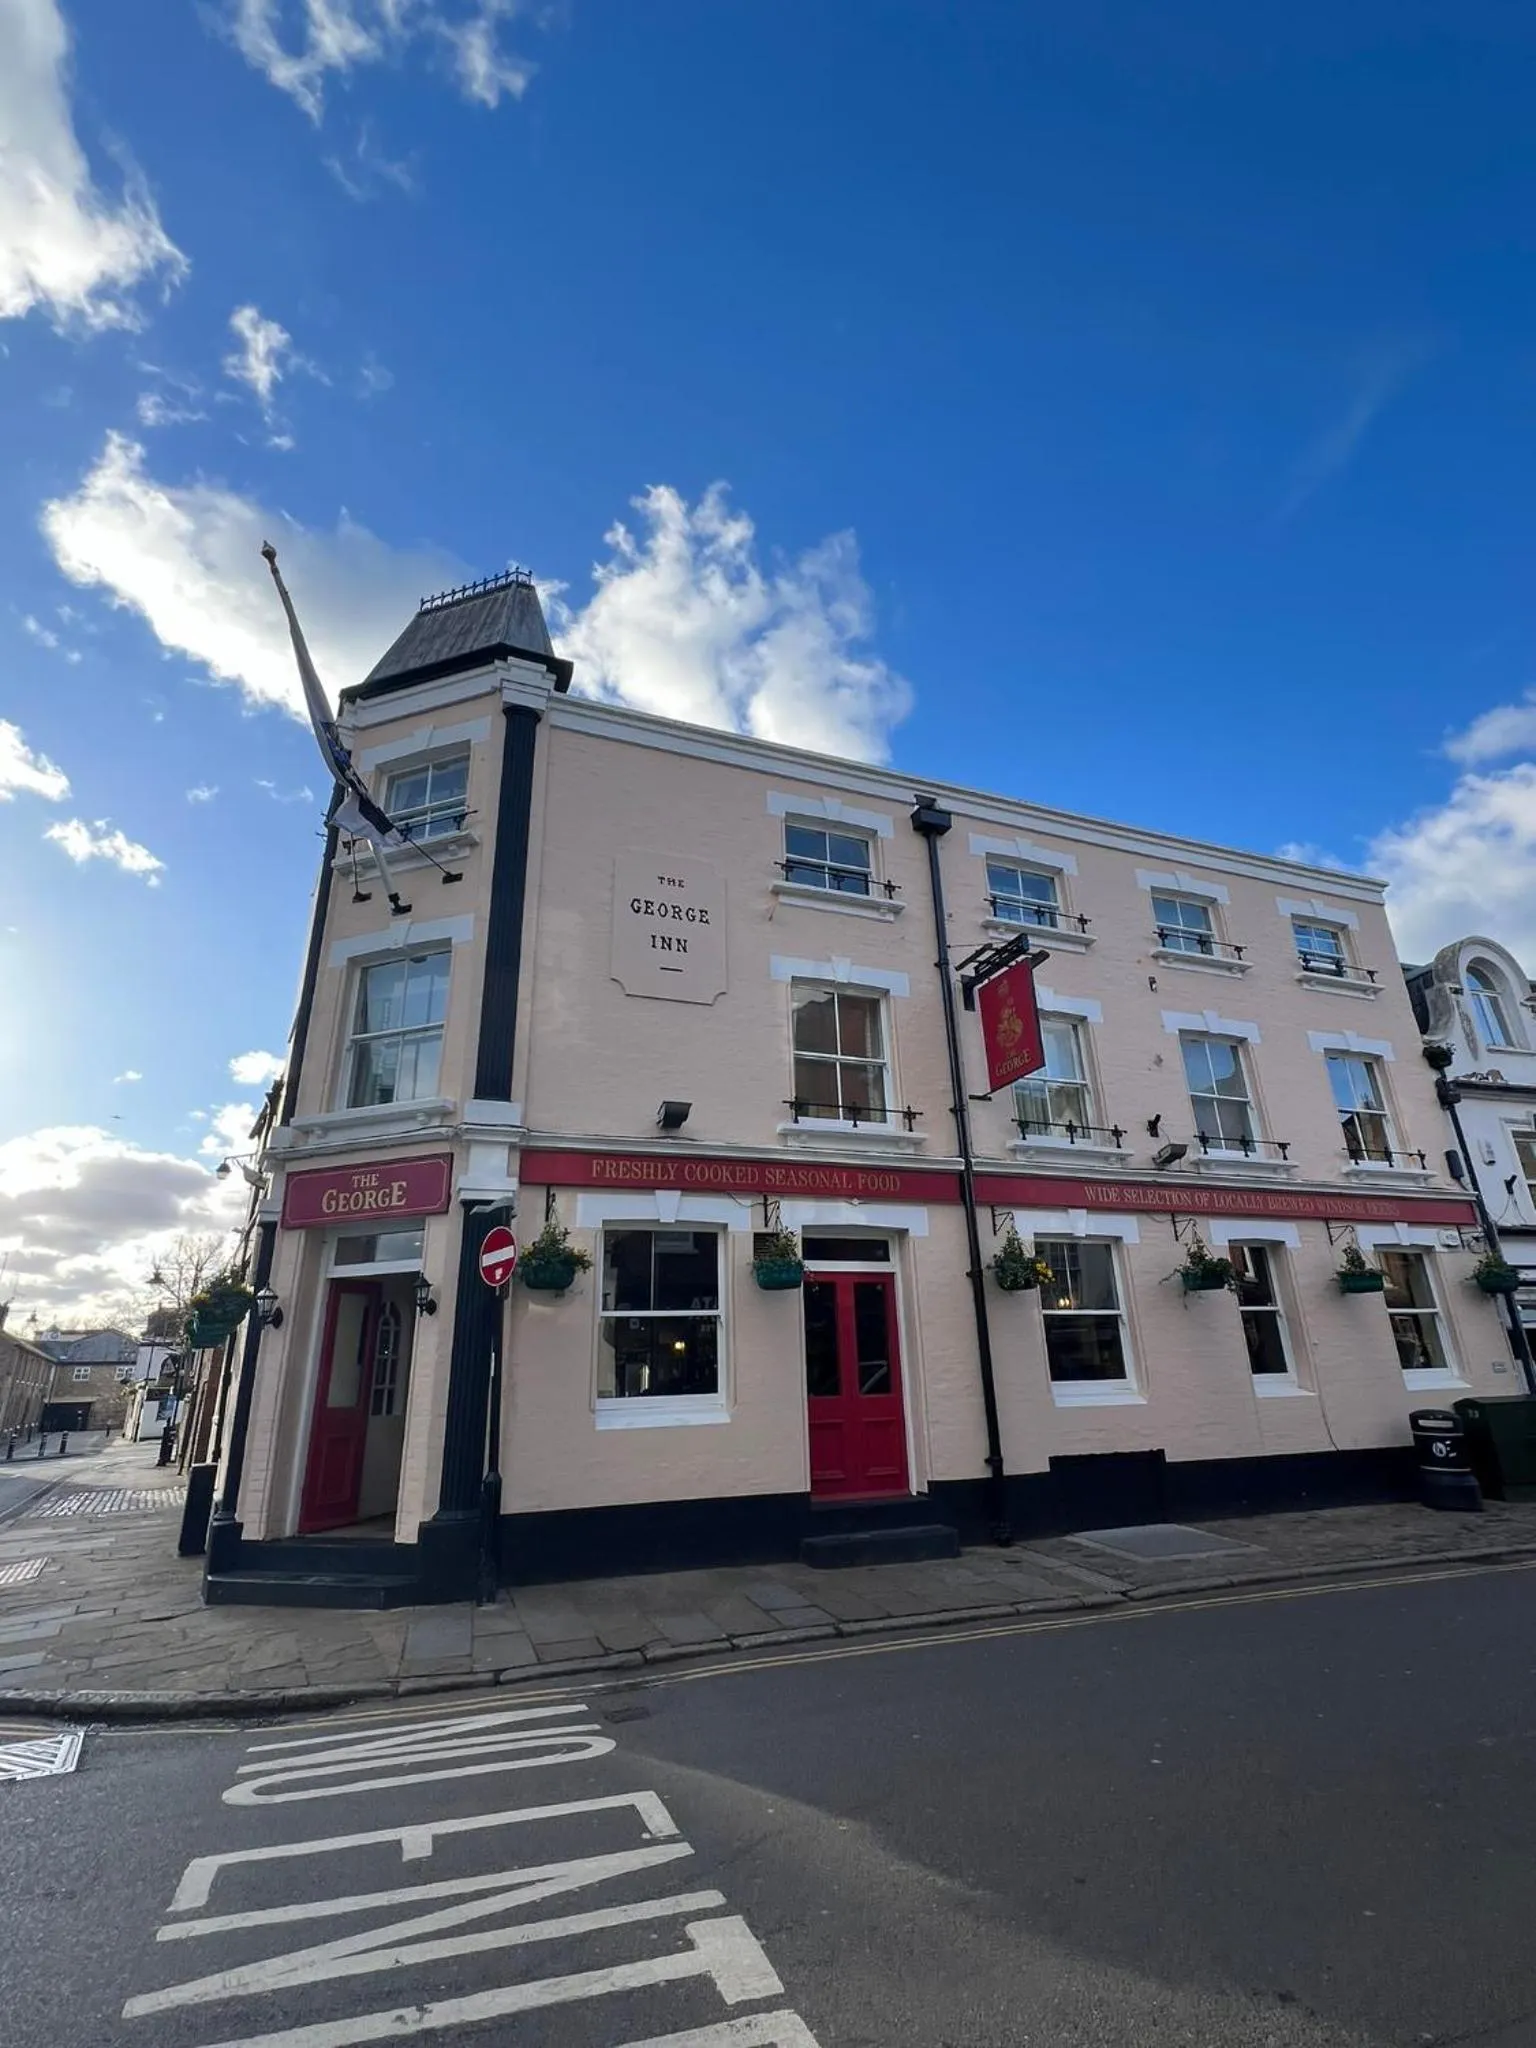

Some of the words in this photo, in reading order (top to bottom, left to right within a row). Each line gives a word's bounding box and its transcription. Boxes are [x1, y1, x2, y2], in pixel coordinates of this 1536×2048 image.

[657, 876, 685, 888] THE
[630, 898, 711, 925] GEORGE
[650, 934, 689, 953] INN
[995, 1048, 1033, 1077] GEORGE
[351, 1173, 380, 1189] THE
[592, 1158, 678, 1182] FRESHLY
[684, 1163, 759, 1185] COOKED
[765, 1167, 853, 1190] SEASONAL
[857, 1173, 901, 1192] FOOD
[321, 1181, 408, 1214] GEORGE
[1084, 1184, 1121, 1203] WIDE
[1123, 1187, 1193, 1206] SELECTION
[1195, 1191, 1211, 1206] OF
[1213, 1192, 1265, 1211] LOCALLY
[1267, 1195, 1315, 1212] BREWED
[221, 1704, 616, 1806] NO
[122, 1789, 822, 2048] ENT
